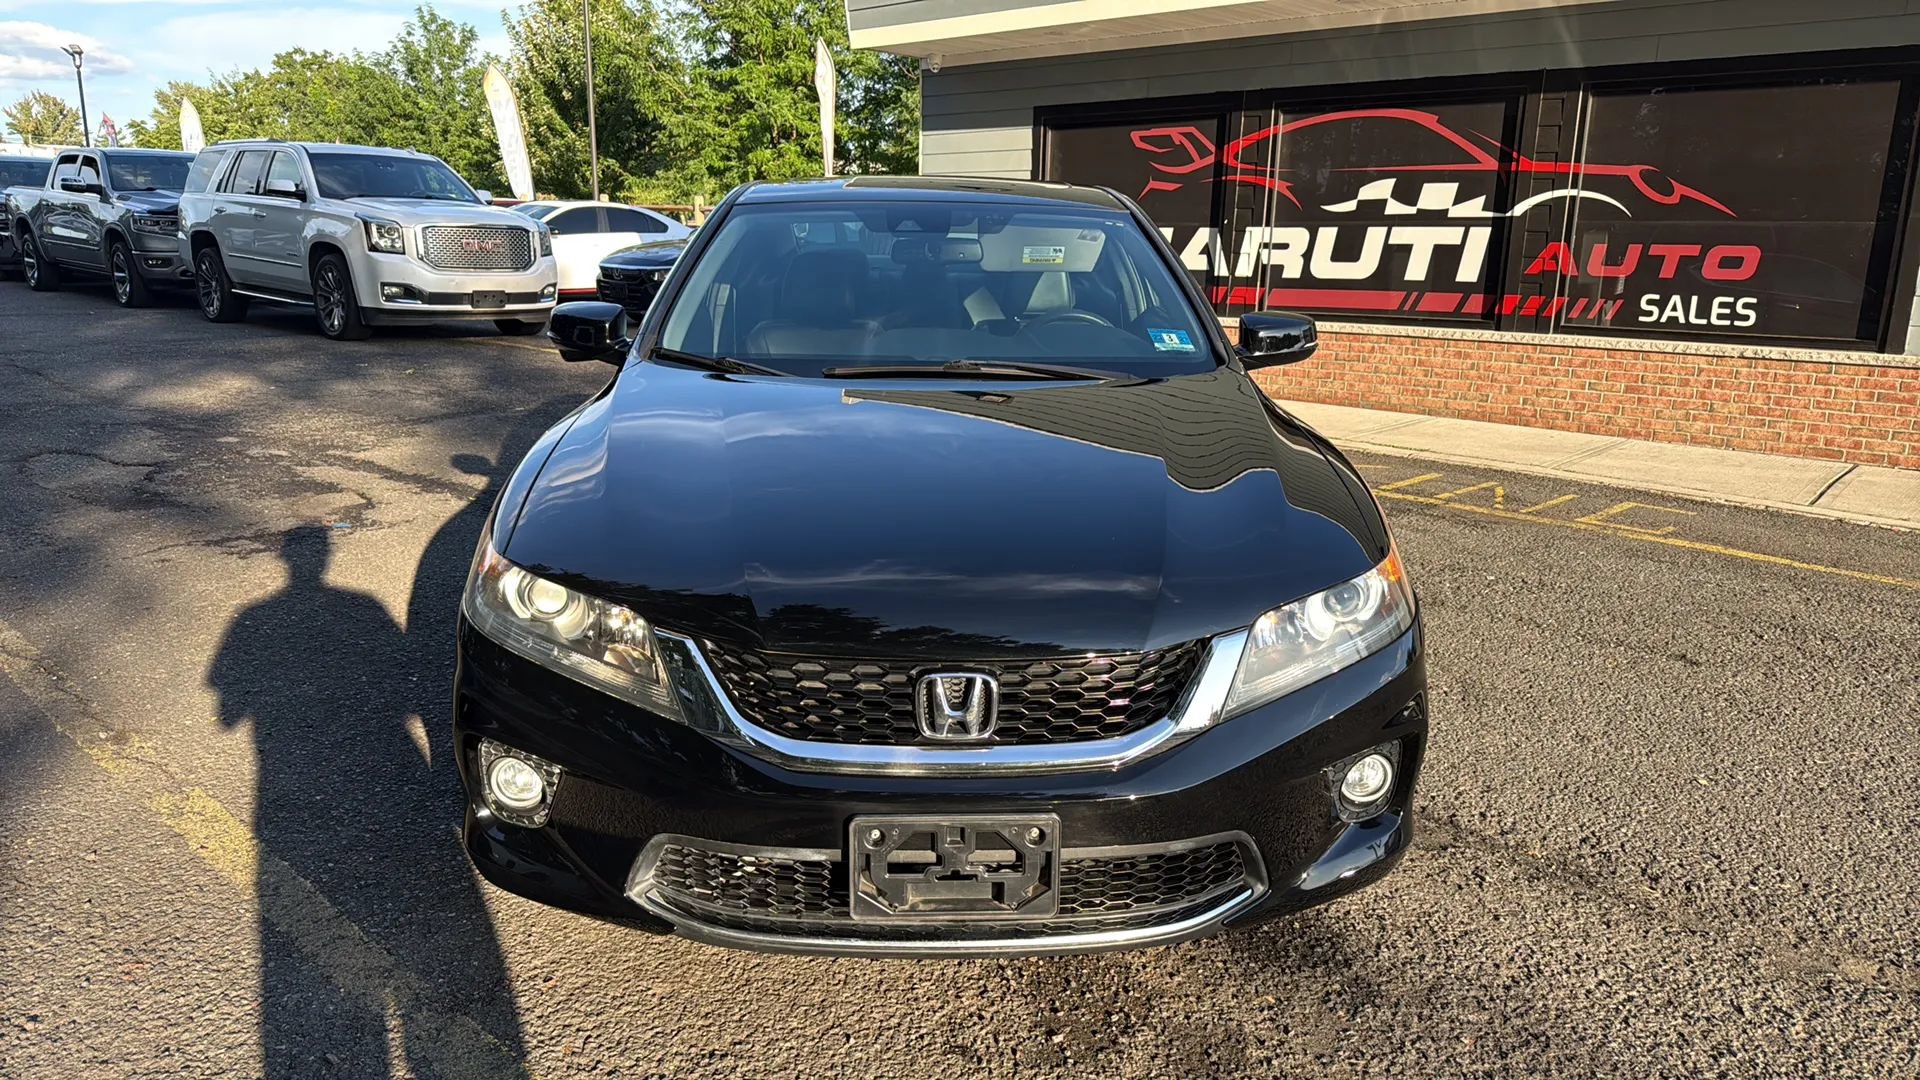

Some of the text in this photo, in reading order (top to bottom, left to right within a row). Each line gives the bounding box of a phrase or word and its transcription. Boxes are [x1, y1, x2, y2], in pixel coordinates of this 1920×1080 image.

[1158, 226, 1762, 283] ARUTI AUTO
[1638, 293, 1758, 327] SALES
